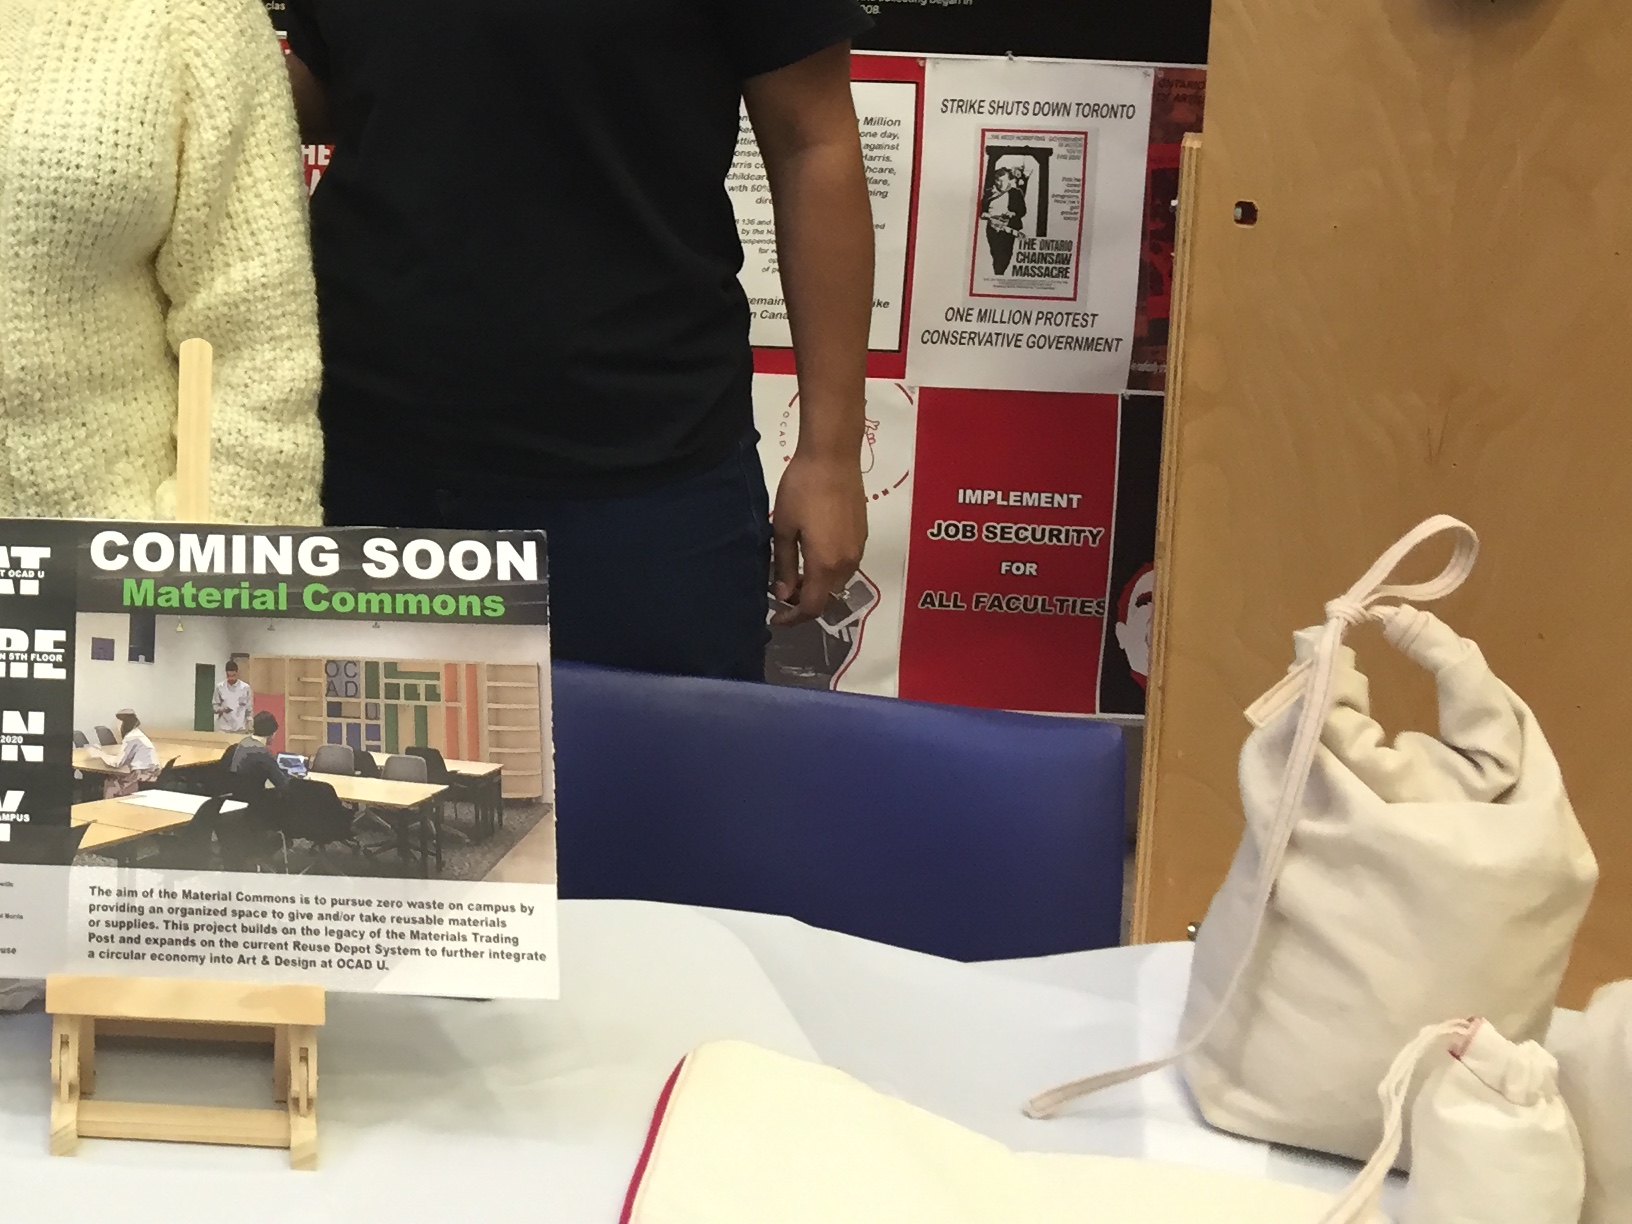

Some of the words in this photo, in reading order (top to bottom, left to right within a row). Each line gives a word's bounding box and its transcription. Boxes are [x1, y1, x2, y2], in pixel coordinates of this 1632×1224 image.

[958, 489, 1082, 508] IMPLEMENT
[927, 520, 978, 541] JOB
[982, 522, 1105, 547] SECURITY
[91, 531, 339, 576] COMING
[362, 538, 537, 580] SOON
[8, 570, 35, 578] OCAD
[1001, 561, 1038, 577] FOR
[123, 578, 287, 610] Material
[303, 583, 505, 616] Commons
[918, 590, 967, 611] ALL
[8, 653, 28, 661] 5TH
[31, 653, 62, 662] FLOOR
[0, 735, 23, 743] 2020
[89, 886, 112, 897] The
[116, 887, 138, 897] aim
[142, 888, 153, 898] of
[159, 889, 177, 899] the
[182, 890, 231, 901] Material
[236, 892, 295, 903] Commons
[300, 894, 310, 904] is
[314, 895, 326, 905] to
[331, 898, 372, 908] pursue
[377, 900, 403, 908] zero
[407, 900, 444, 909] waste
[448, 901, 464, 912] on
[468, 903, 516, 914] campus
[521, 903, 534, 915] by
